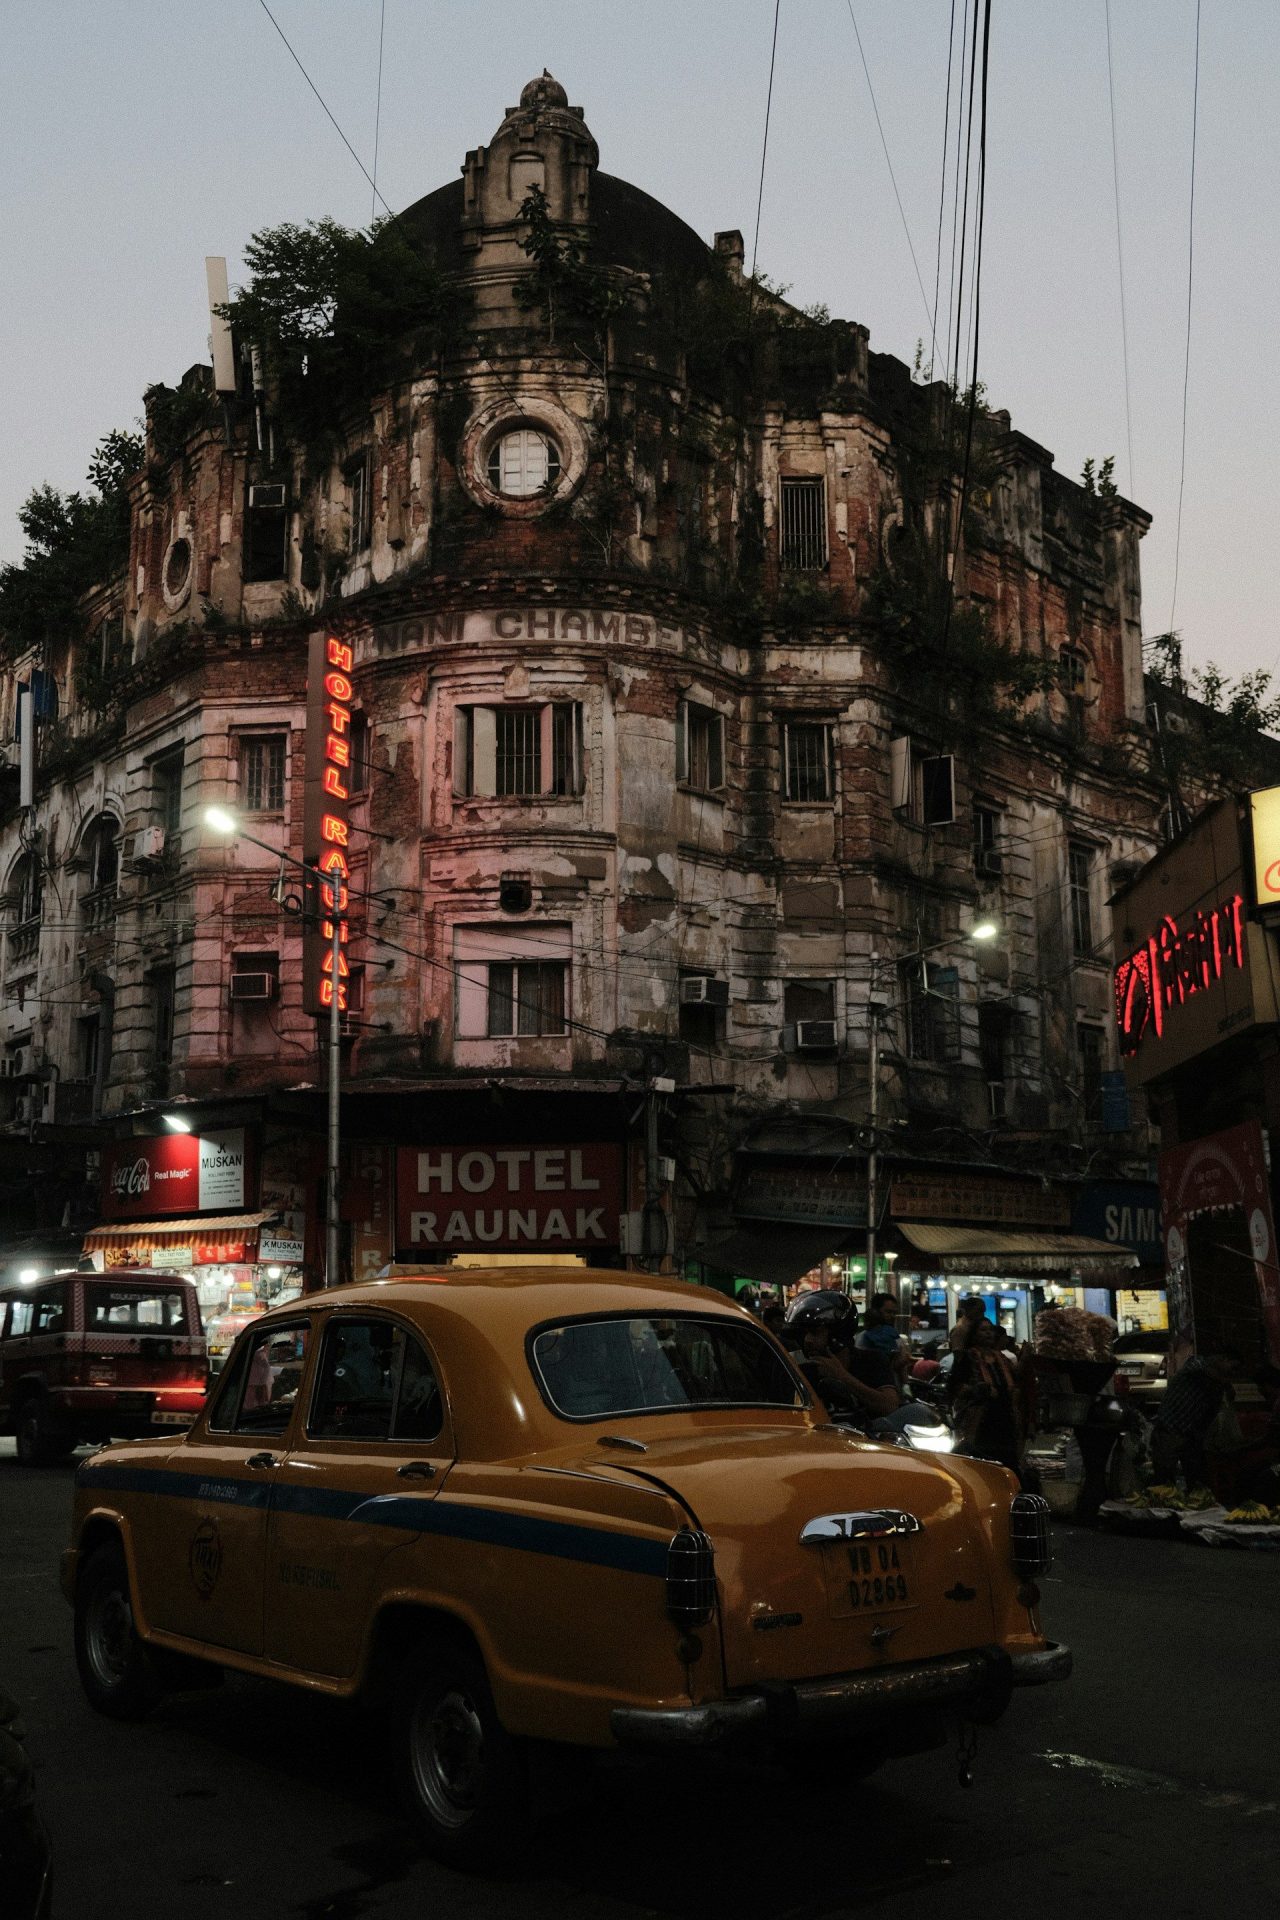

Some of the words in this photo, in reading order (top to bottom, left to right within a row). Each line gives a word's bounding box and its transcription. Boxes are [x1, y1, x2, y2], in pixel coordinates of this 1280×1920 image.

[323, 637, 352, 800] HOTEL
[320, 813, 349, 1011] RAUNAK
[202, 1154, 243, 1169] MUSKAN
[217, 1142, 226, 1154] JK
[154, 1171, 169, 1180] Real
[417, 1149, 600, 1194] HOTEL
[410, 1207, 608, 1243] RAUNAK
[262, 1240, 270, 1248] JK
[270, 1241, 302, 1250] MUSKAN
[847, 1546, 871, 1575] WB
[879, 1543, 900, 1572] 04
